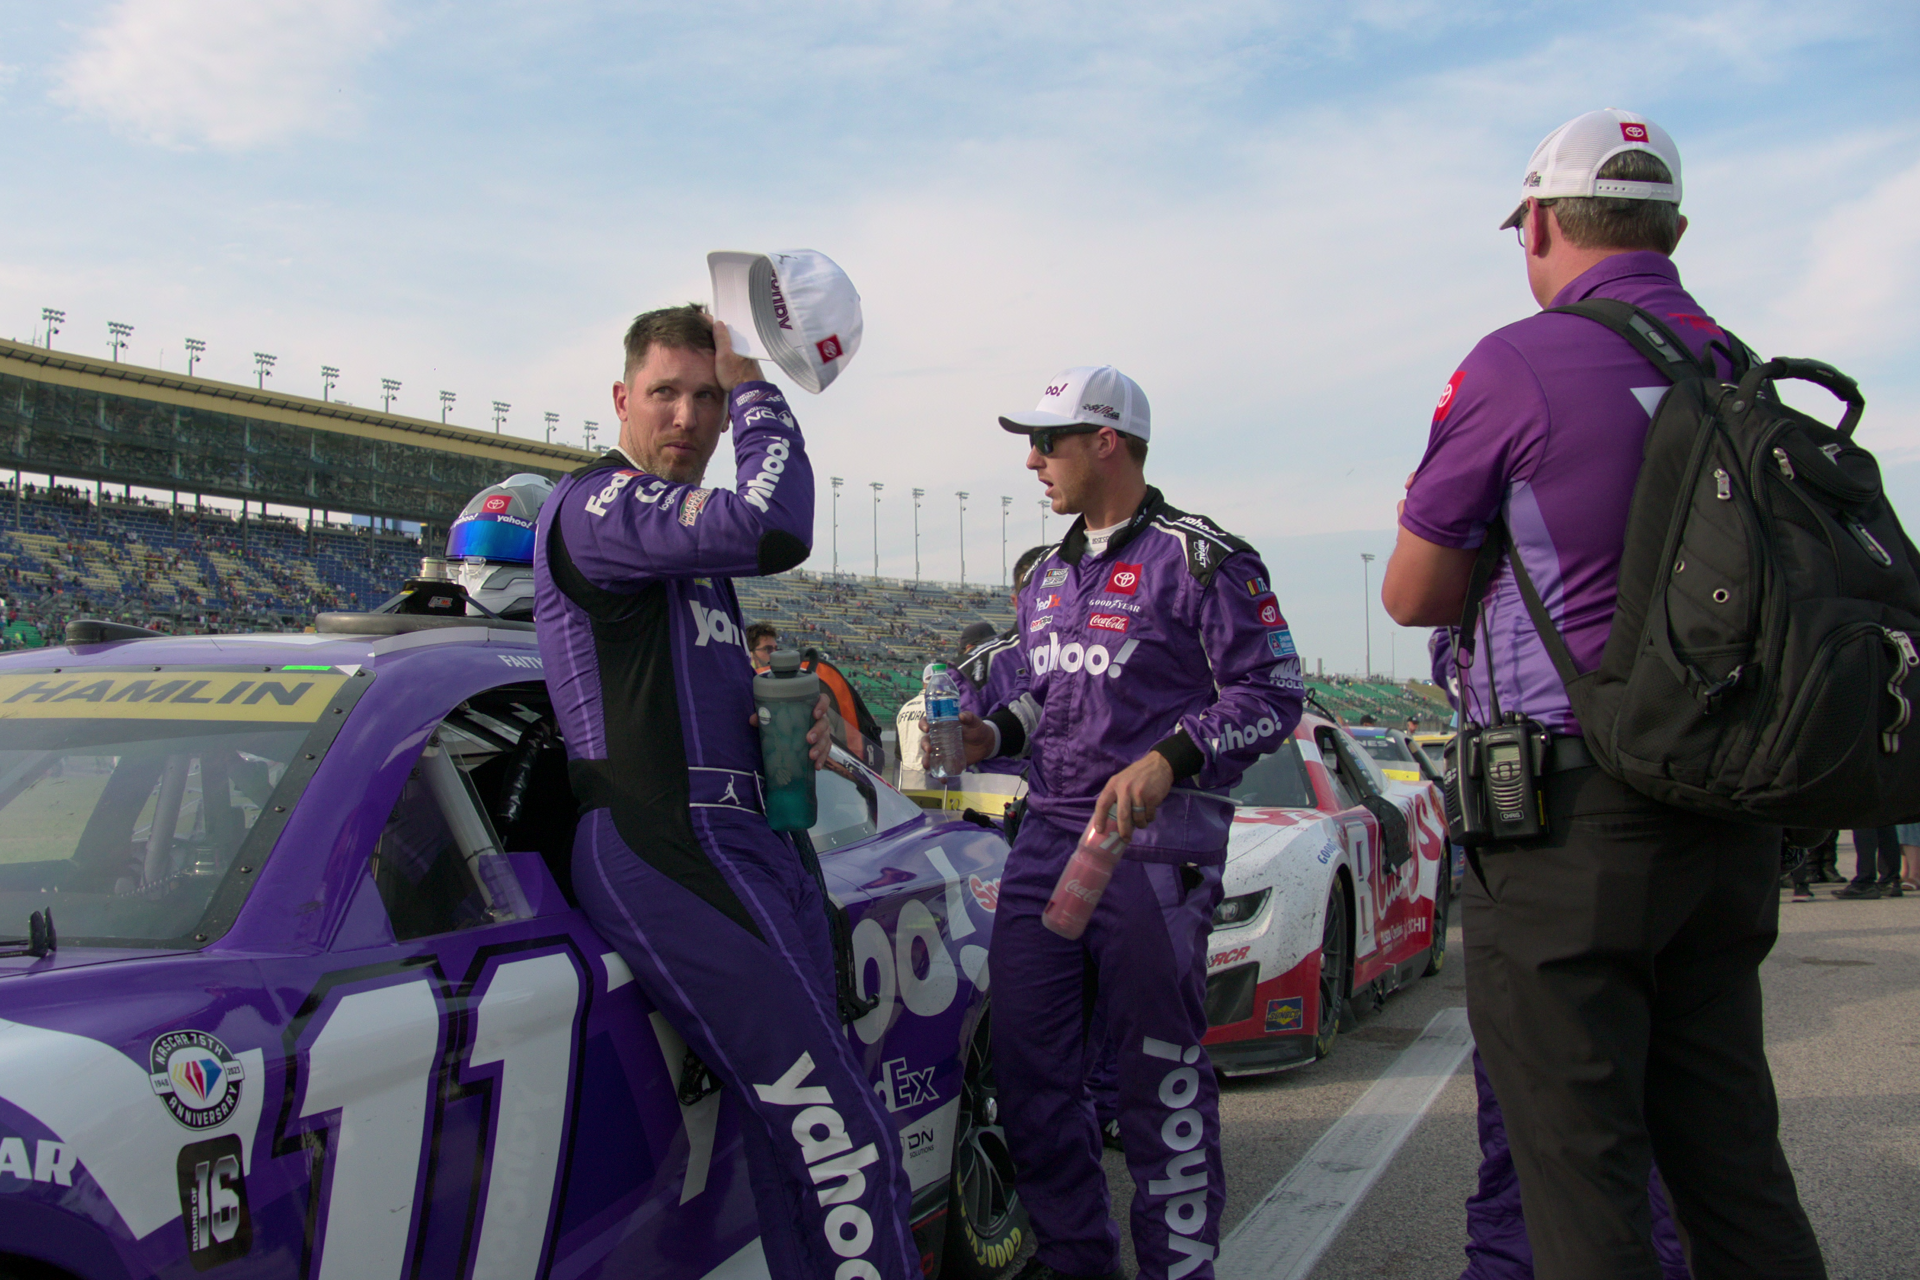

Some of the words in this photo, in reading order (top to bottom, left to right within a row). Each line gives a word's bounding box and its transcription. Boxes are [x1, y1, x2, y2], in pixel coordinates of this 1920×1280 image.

[497, 514, 533, 529] yahoo!
[1089, 599, 1141, 613] GOODYEAR
[1026, 632, 1140, 679] ahoo!
[8, 679, 315, 706] HAMLIN
[1213, 946, 1249, 967] RCR
[1269, 1008, 1301, 1020] SUNOCO
[155, 1033, 190, 1065] NASCAR
[190, 1033, 223, 1056] 75TH
[227, 1066, 241, 1076] 2023
[168, 1085, 237, 1126] ANNIVERSARY
[298, 952, 580, 1280] 11
[908, 1128, 934, 1149] DN
[909, 1144, 934, 1159] SOLUTIONS
[1143, 1036, 1216, 1280] yahoo!
[191, 1187, 198, 1204] OF
[195, 1154, 239, 1250] 16
